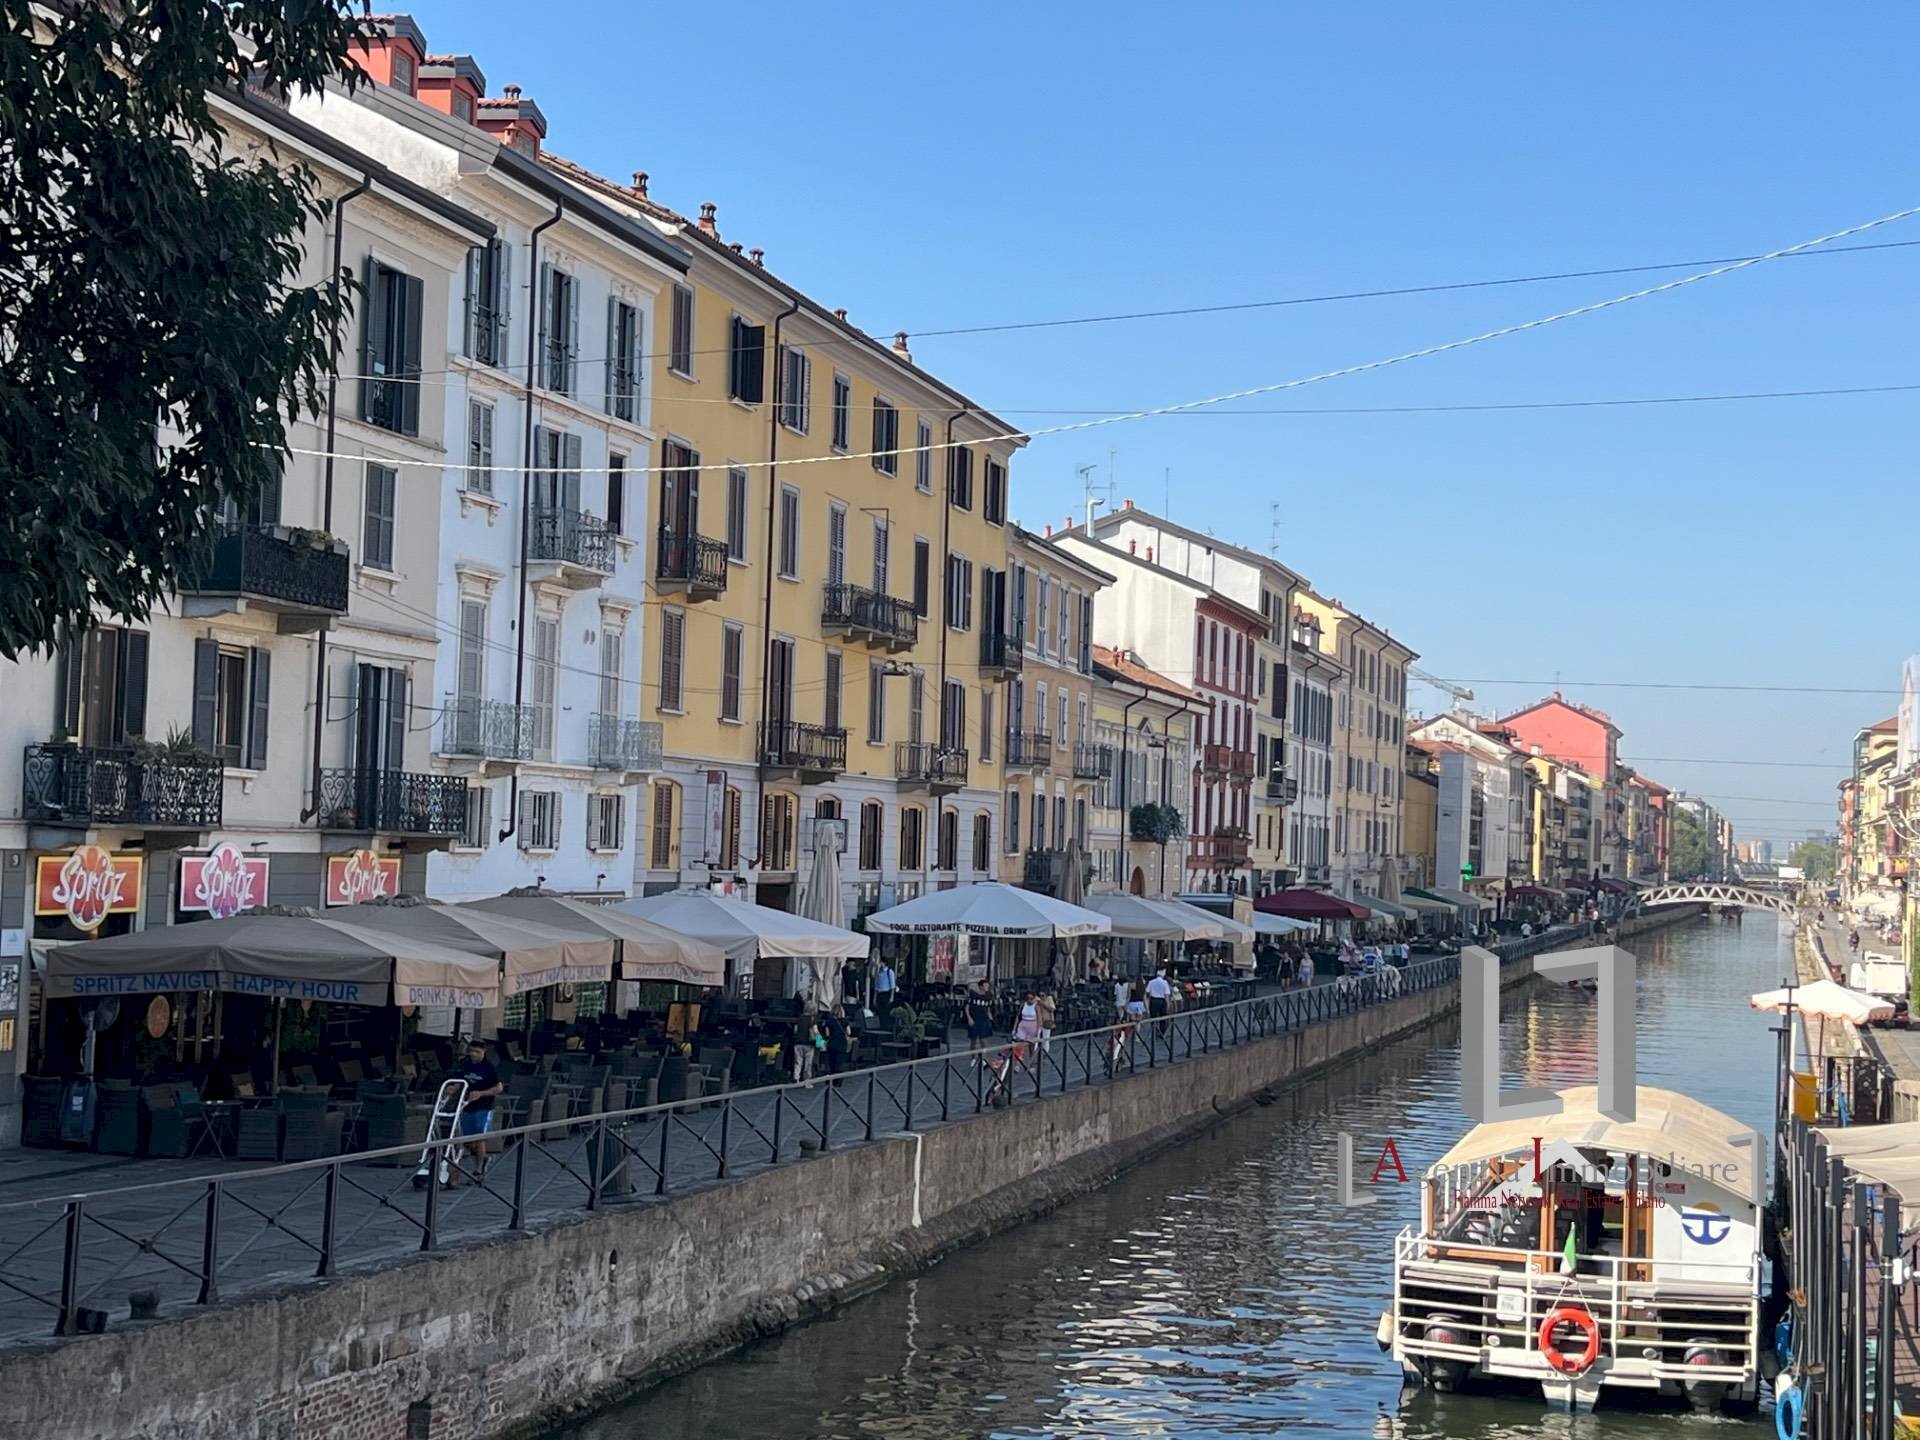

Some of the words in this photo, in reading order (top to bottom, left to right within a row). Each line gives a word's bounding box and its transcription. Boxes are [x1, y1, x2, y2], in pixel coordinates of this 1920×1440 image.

[12, 854, 20, 866] 9
[52, 854, 127, 904] Spritz
[195, 854, 256, 901] Spritz
[339, 855, 389, 900] Spritz
[72, 975, 137, 994] SPRITZ
[143, 971, 221, 990] NAVIGLI
[232, 975, 296, 997] HAPPY
[302, 981, 360, 1002] HOUR
